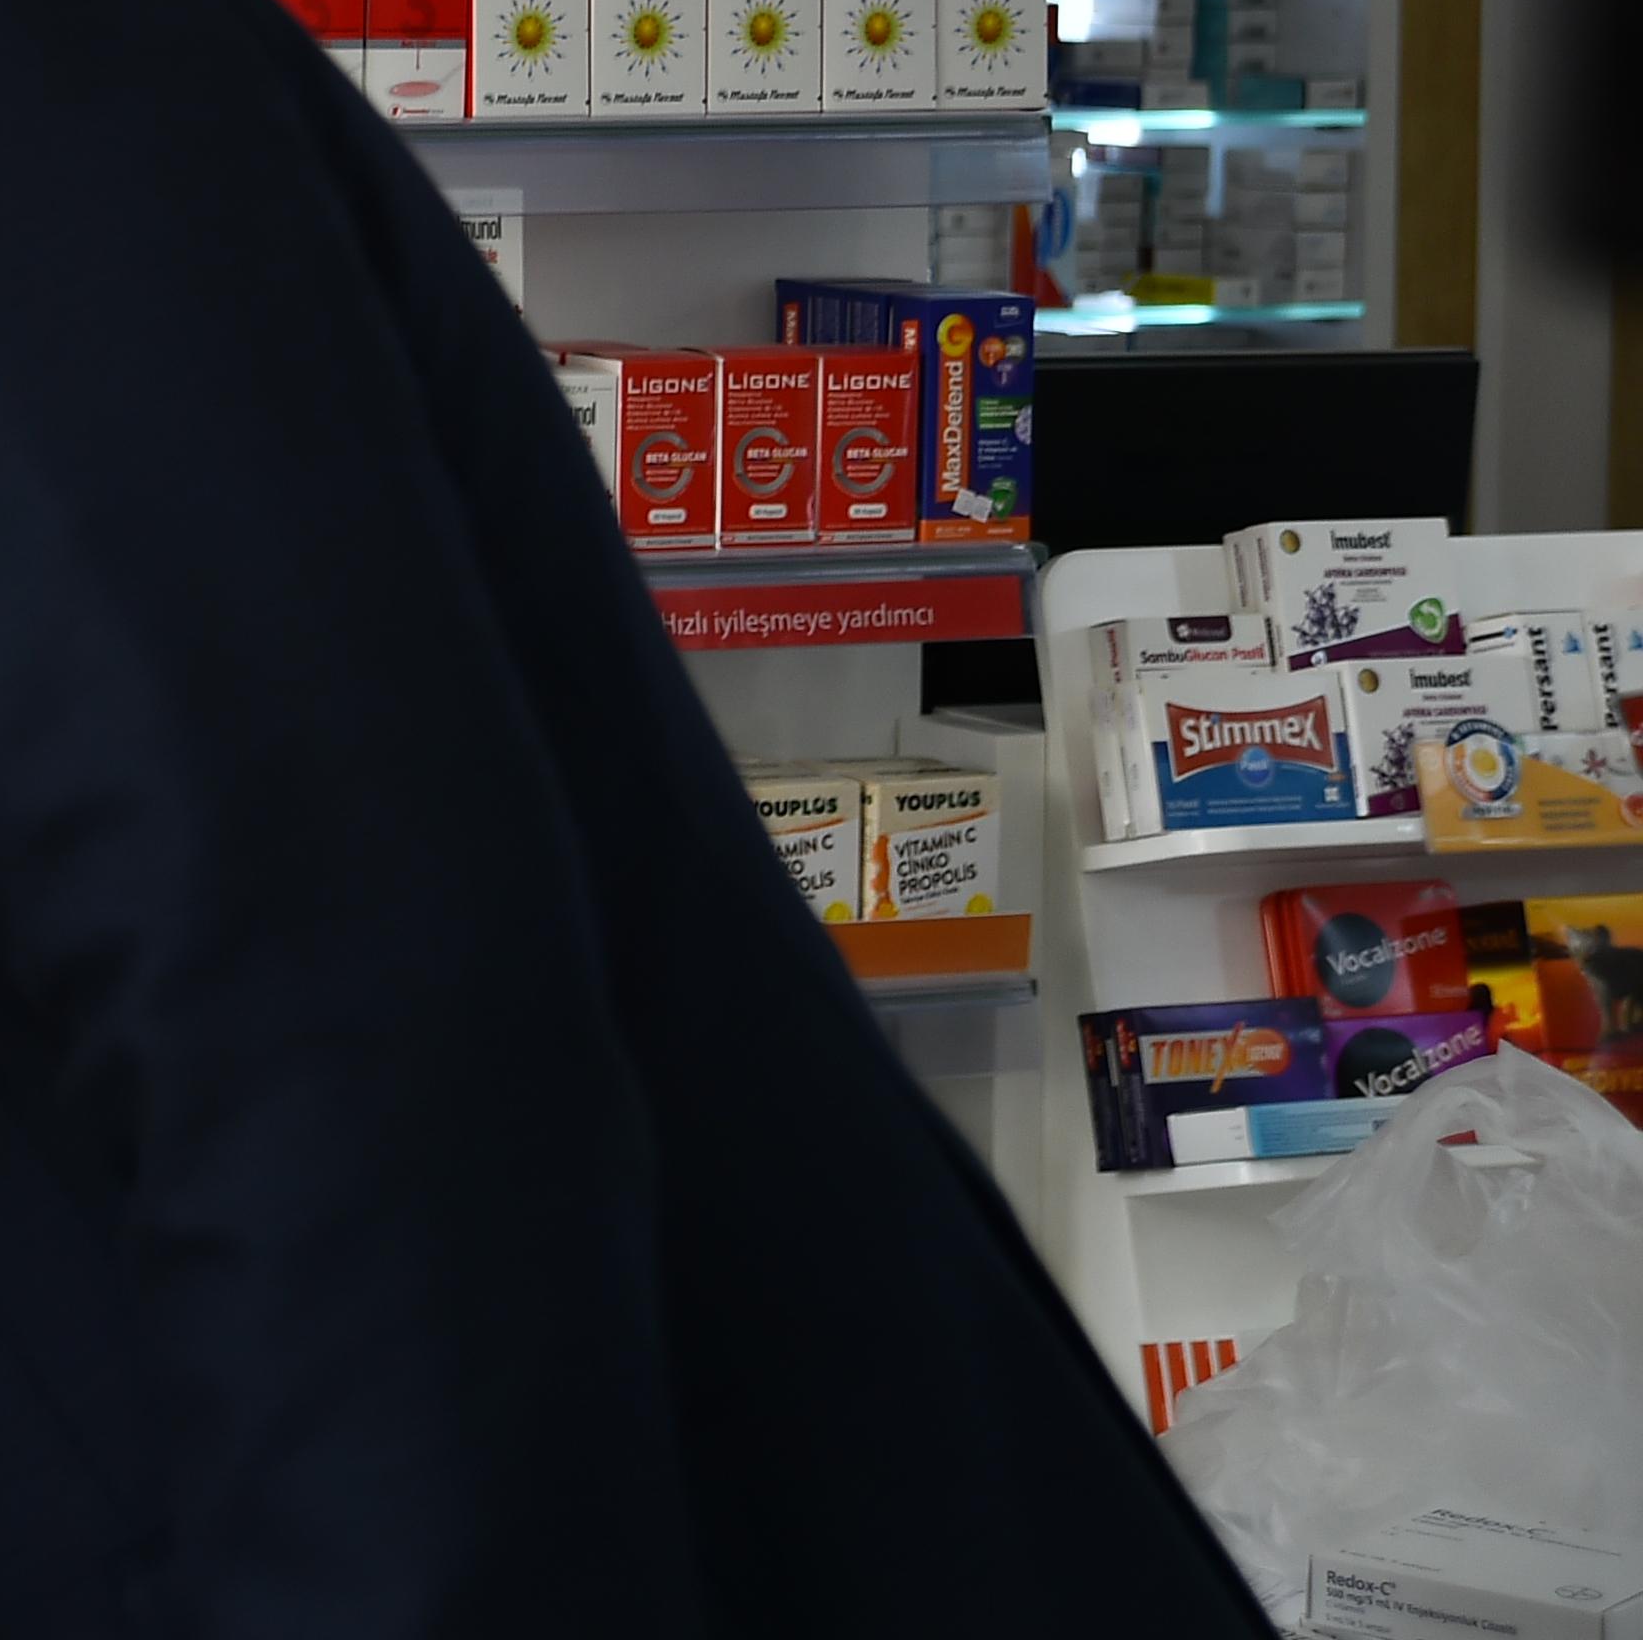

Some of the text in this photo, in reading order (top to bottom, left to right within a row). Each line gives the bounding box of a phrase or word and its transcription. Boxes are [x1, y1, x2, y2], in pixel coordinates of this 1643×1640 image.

[942, 360, 963, 493] MaxDefend
[661, 605, 934, 641] Hızlı iyileşmeye yardımcı
[1181, 712, 1322, 757] Stimmex
[1325, 925, 1448, 977] Vocalzone
[1352, 1024, 1484, 1099] Vocalzone
